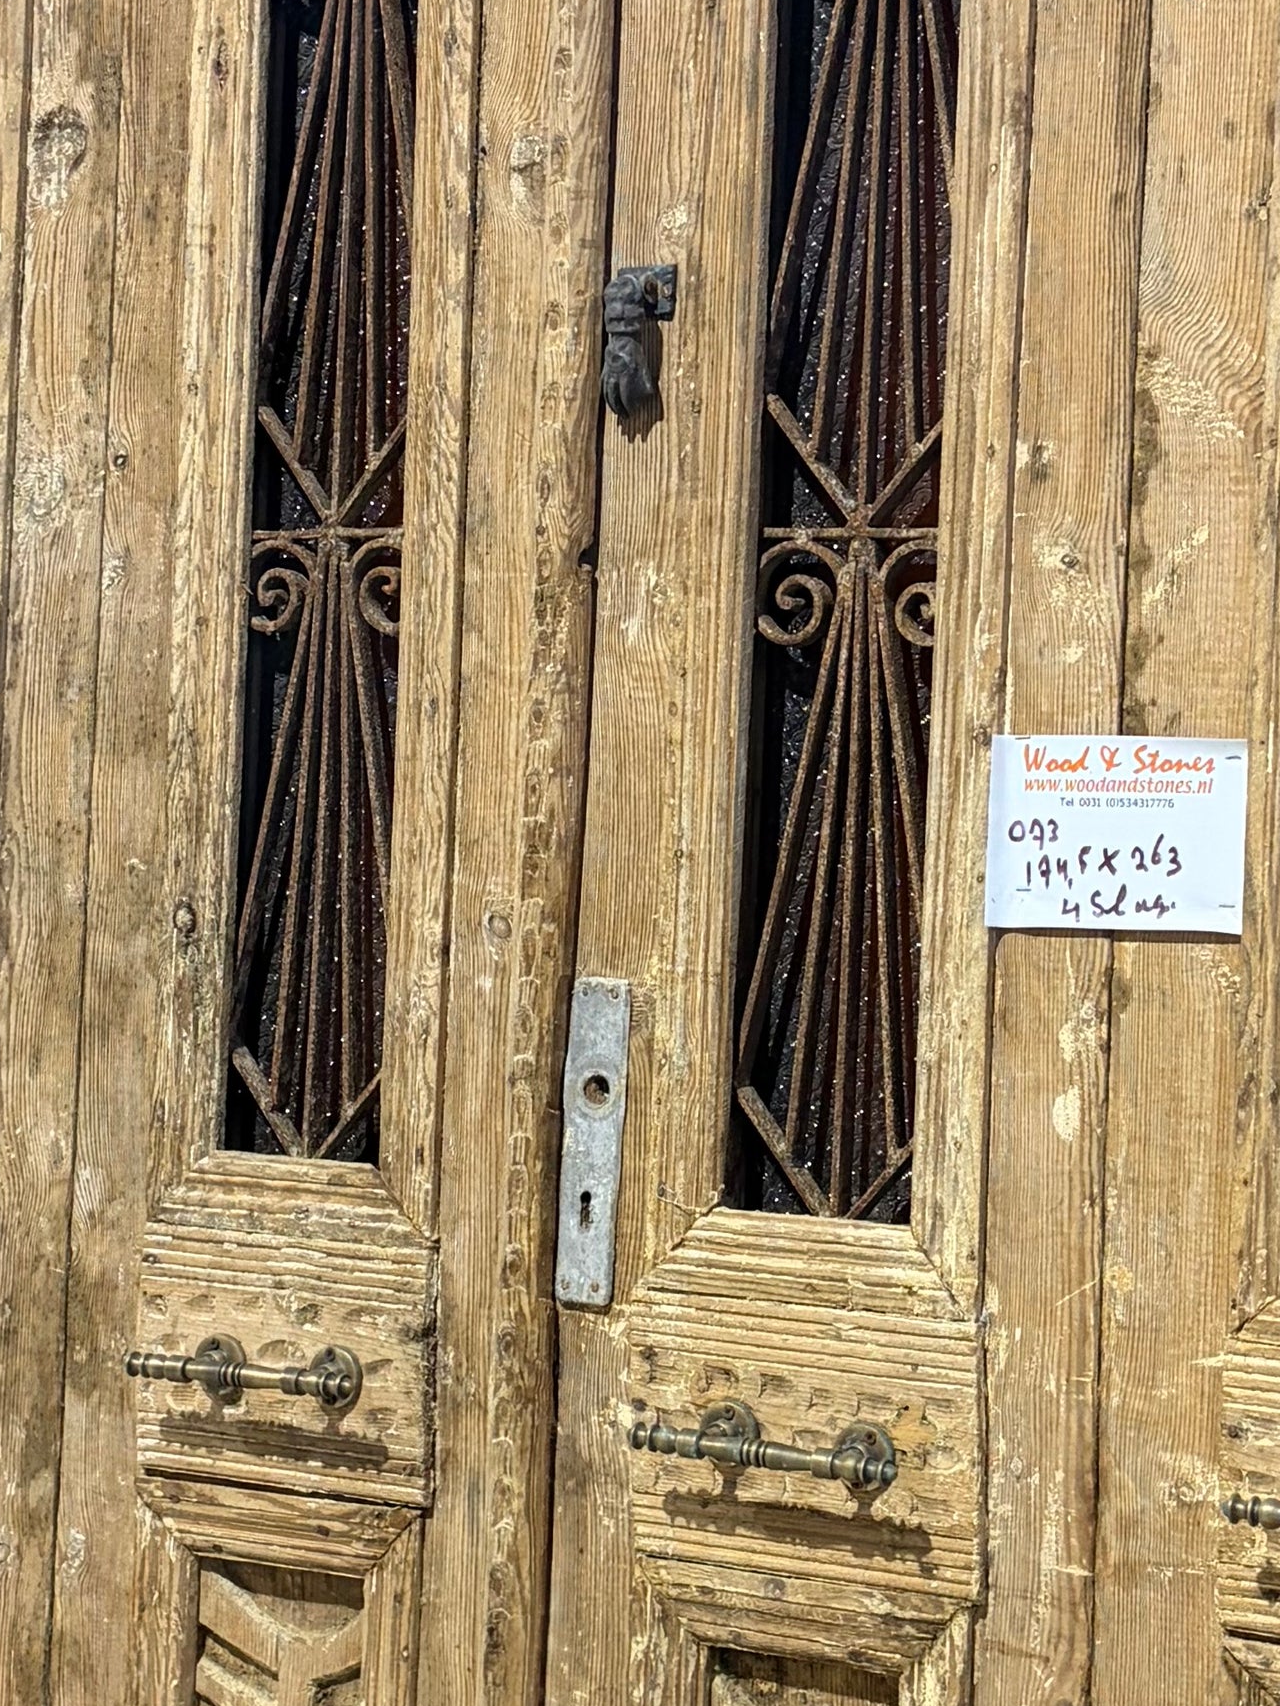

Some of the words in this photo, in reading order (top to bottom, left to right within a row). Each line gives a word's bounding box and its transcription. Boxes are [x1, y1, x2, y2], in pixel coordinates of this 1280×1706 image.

[1023, 743, 1090, 773] Wood
[1100, 745, 1122, 772] &
[1133, 744, 1216, 775] Stones
[1024, 777, 1214, 794] www.woodandstones.nl
[1060, 797, 1074, 807] Tel
[1079, 797, 1101, 808] 0031
[1131, 833, 1183, 878] 263
